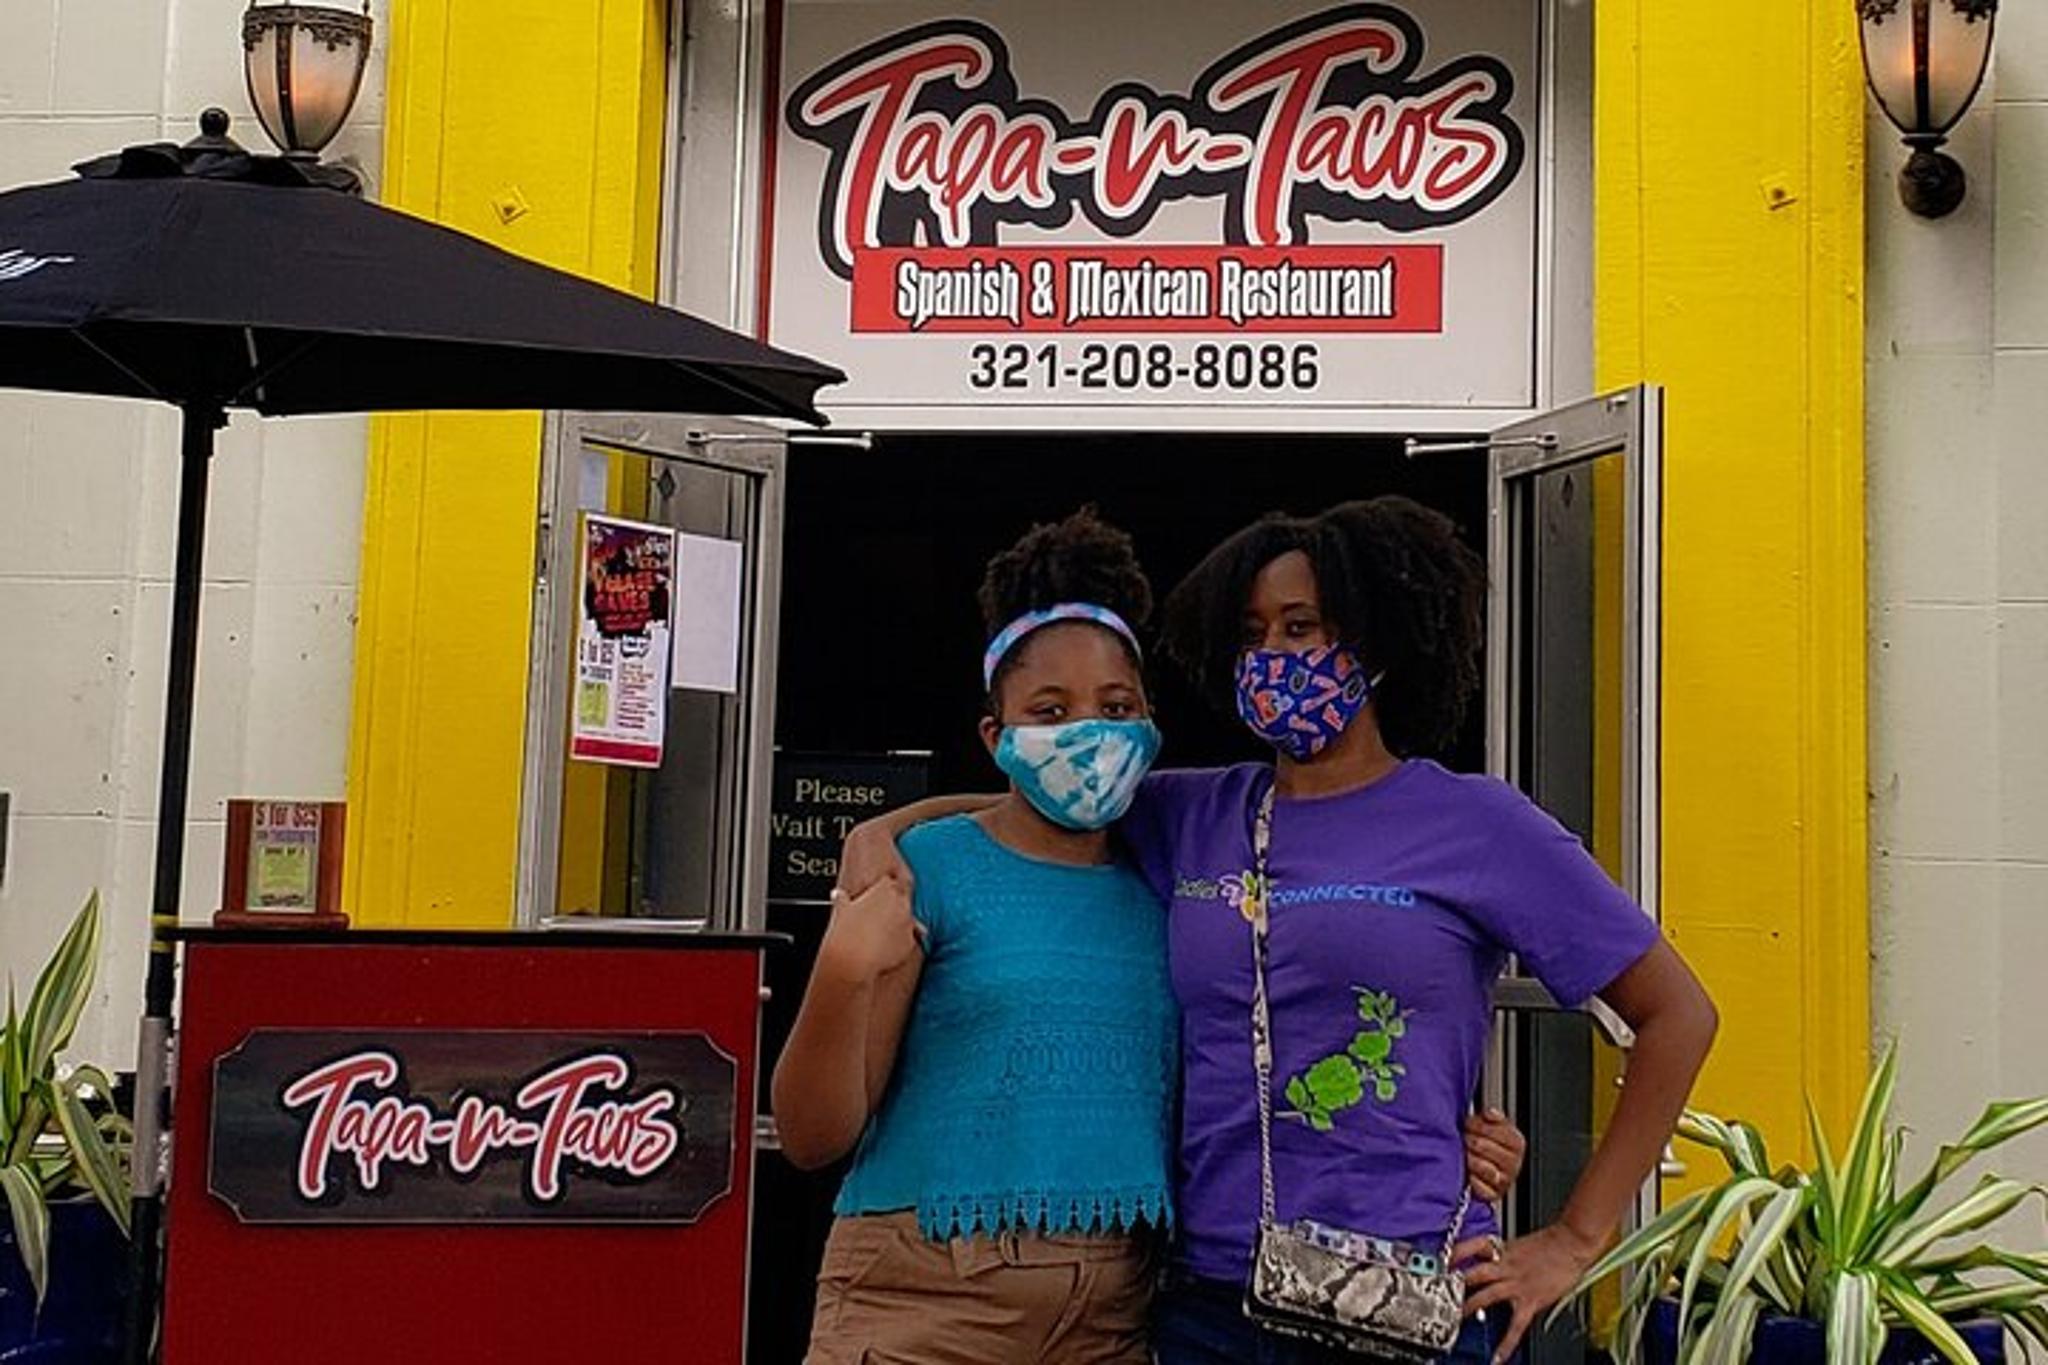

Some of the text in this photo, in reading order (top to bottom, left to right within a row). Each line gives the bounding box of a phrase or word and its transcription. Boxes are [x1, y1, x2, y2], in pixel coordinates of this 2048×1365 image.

[896, 257, 1396, 327] Spanish & Mexican Restaurant
[968, 343, 1320, 390] 321-208-8086
[794, 778, 886, 805] Please
